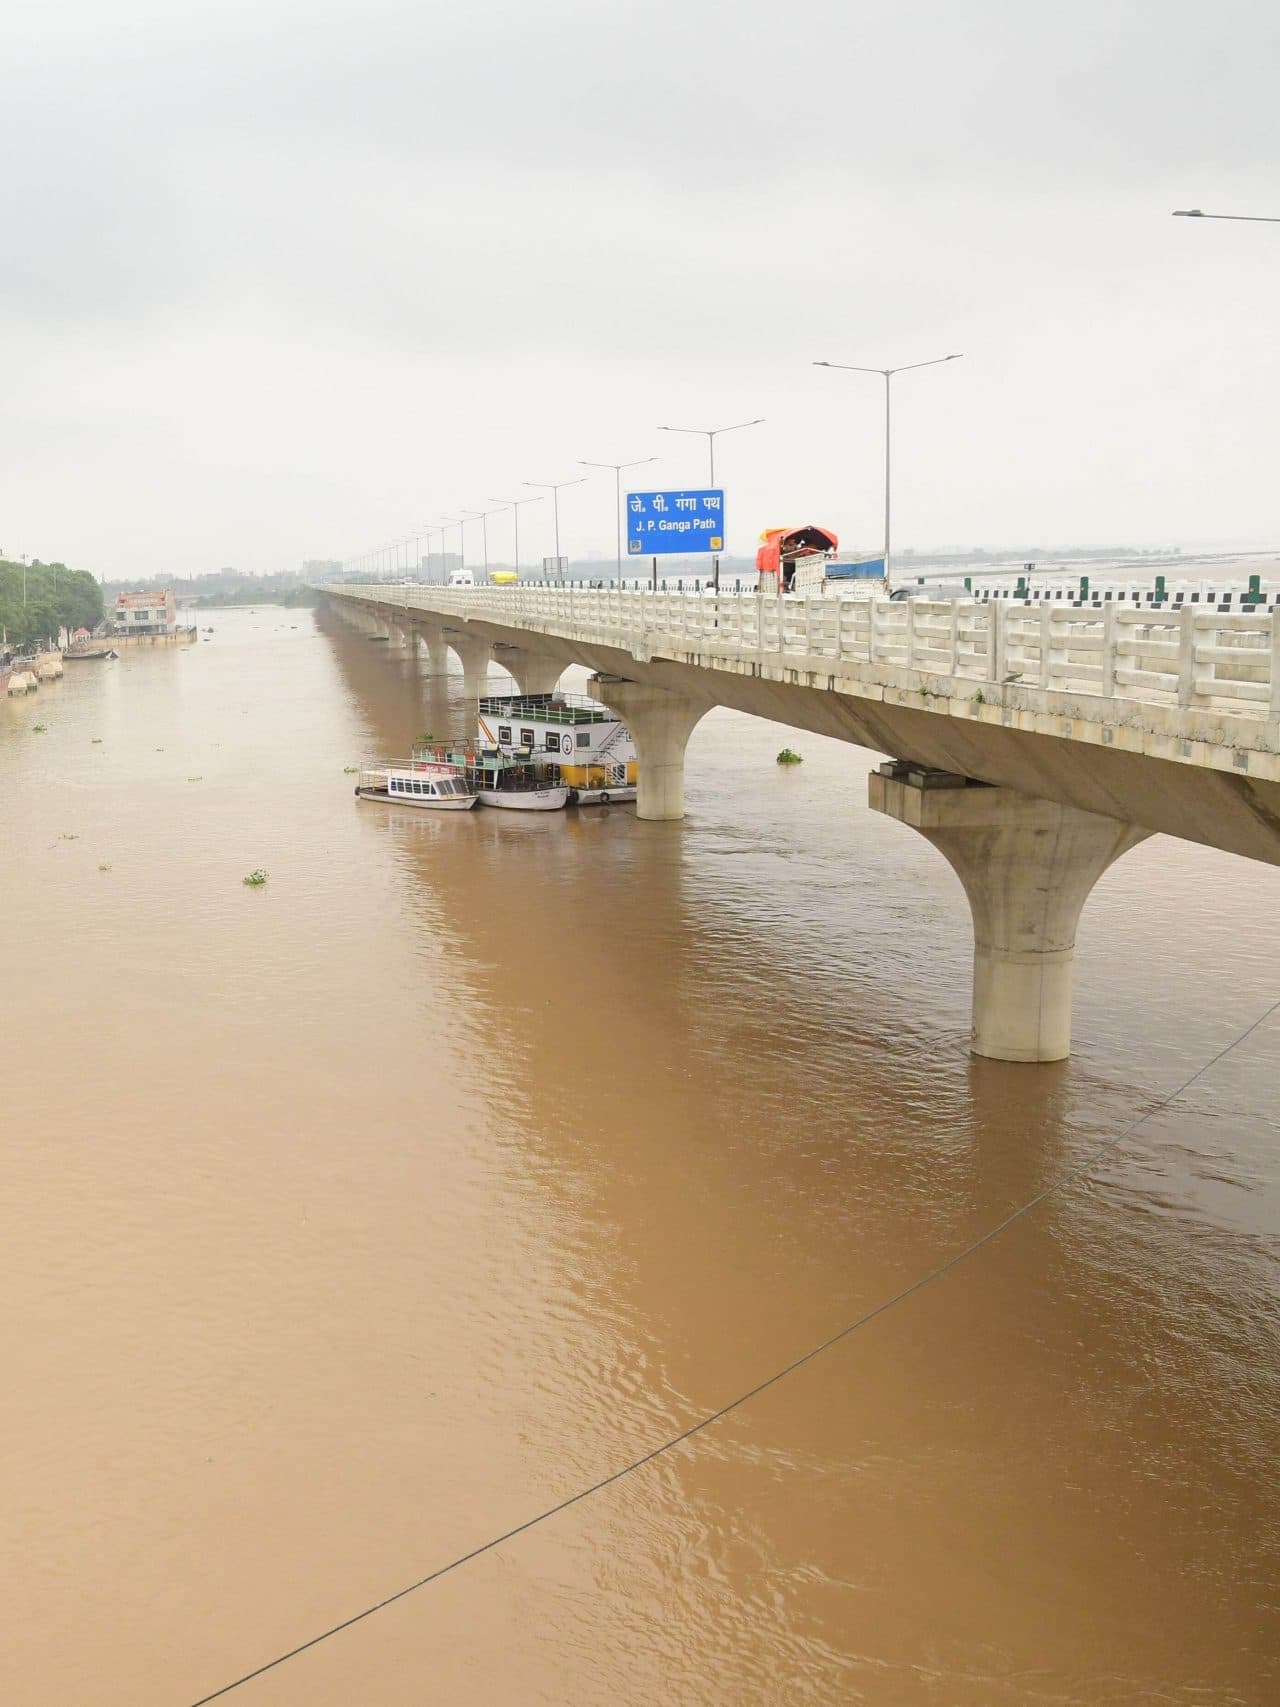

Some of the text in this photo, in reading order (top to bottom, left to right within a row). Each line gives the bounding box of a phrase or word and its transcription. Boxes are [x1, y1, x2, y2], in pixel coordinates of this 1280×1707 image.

[630, 493, 720, 512] जे. पी. गंगा पथ
[636, 518, 715, 532] J. P. Ganga Path
